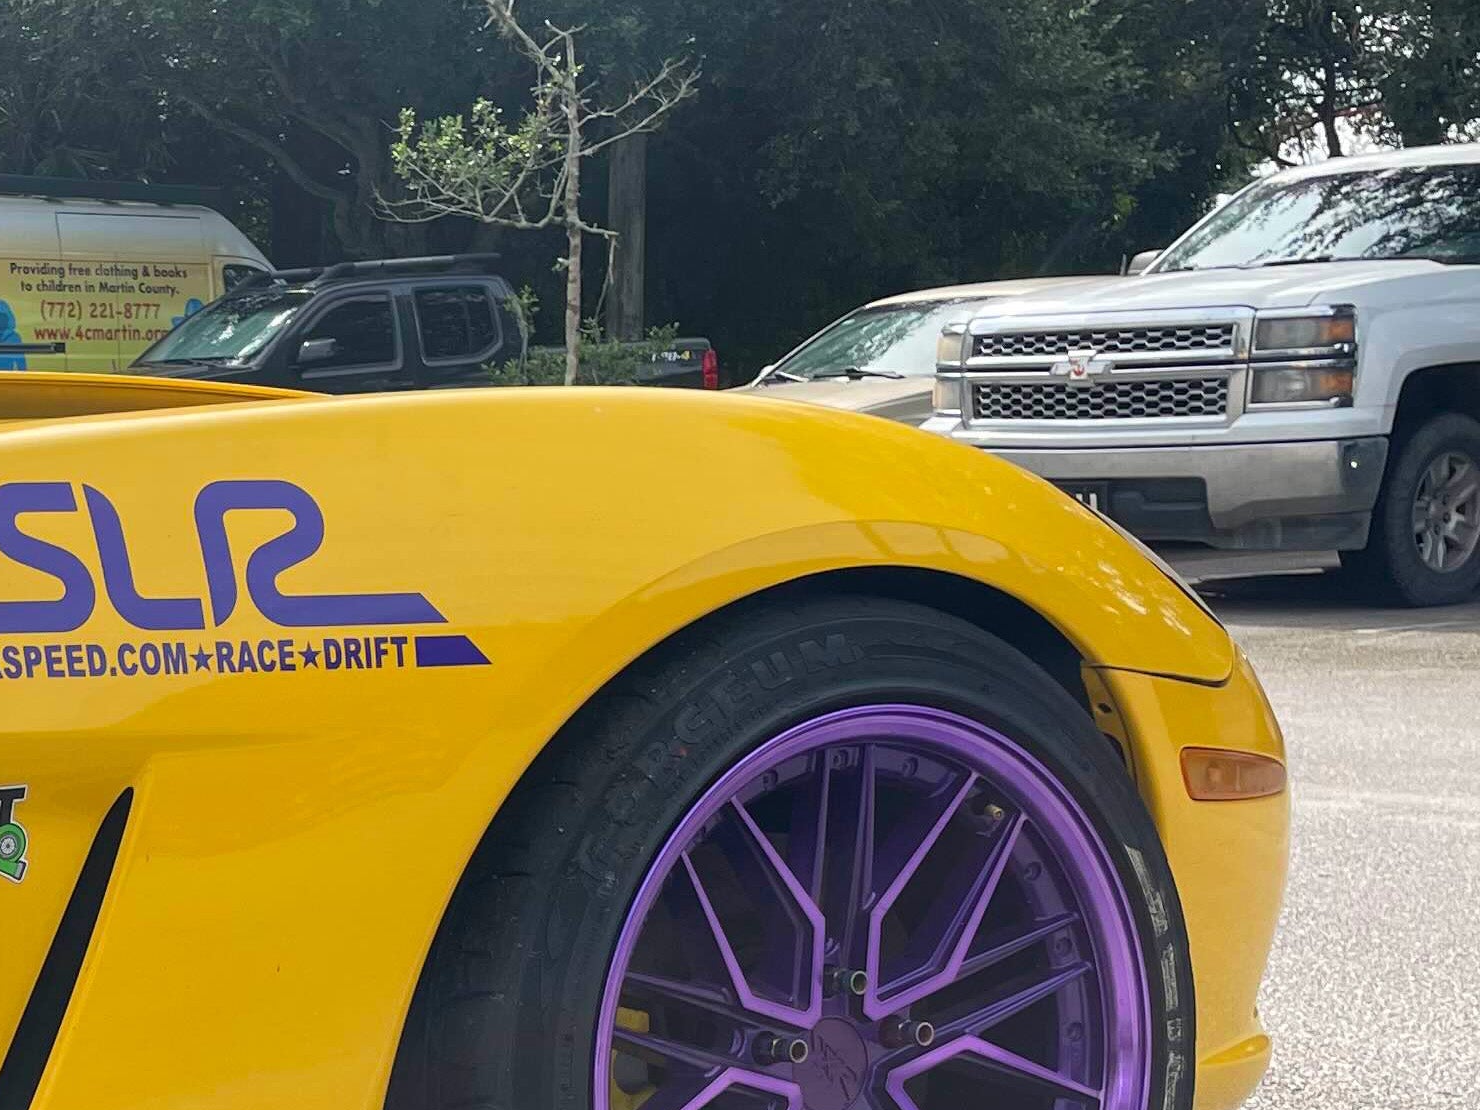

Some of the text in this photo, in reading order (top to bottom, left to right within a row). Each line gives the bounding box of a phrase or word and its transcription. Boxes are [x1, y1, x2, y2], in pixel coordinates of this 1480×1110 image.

[10, 262, 187, 279] Providing free clothing & books
[20, 281, 180, 297] to children in Martin County.
[40, 299, 160, 321] (772) 221-8777
[217, 638, 297, 673] RACE
[322, 636, 409, 670] DRIFT
